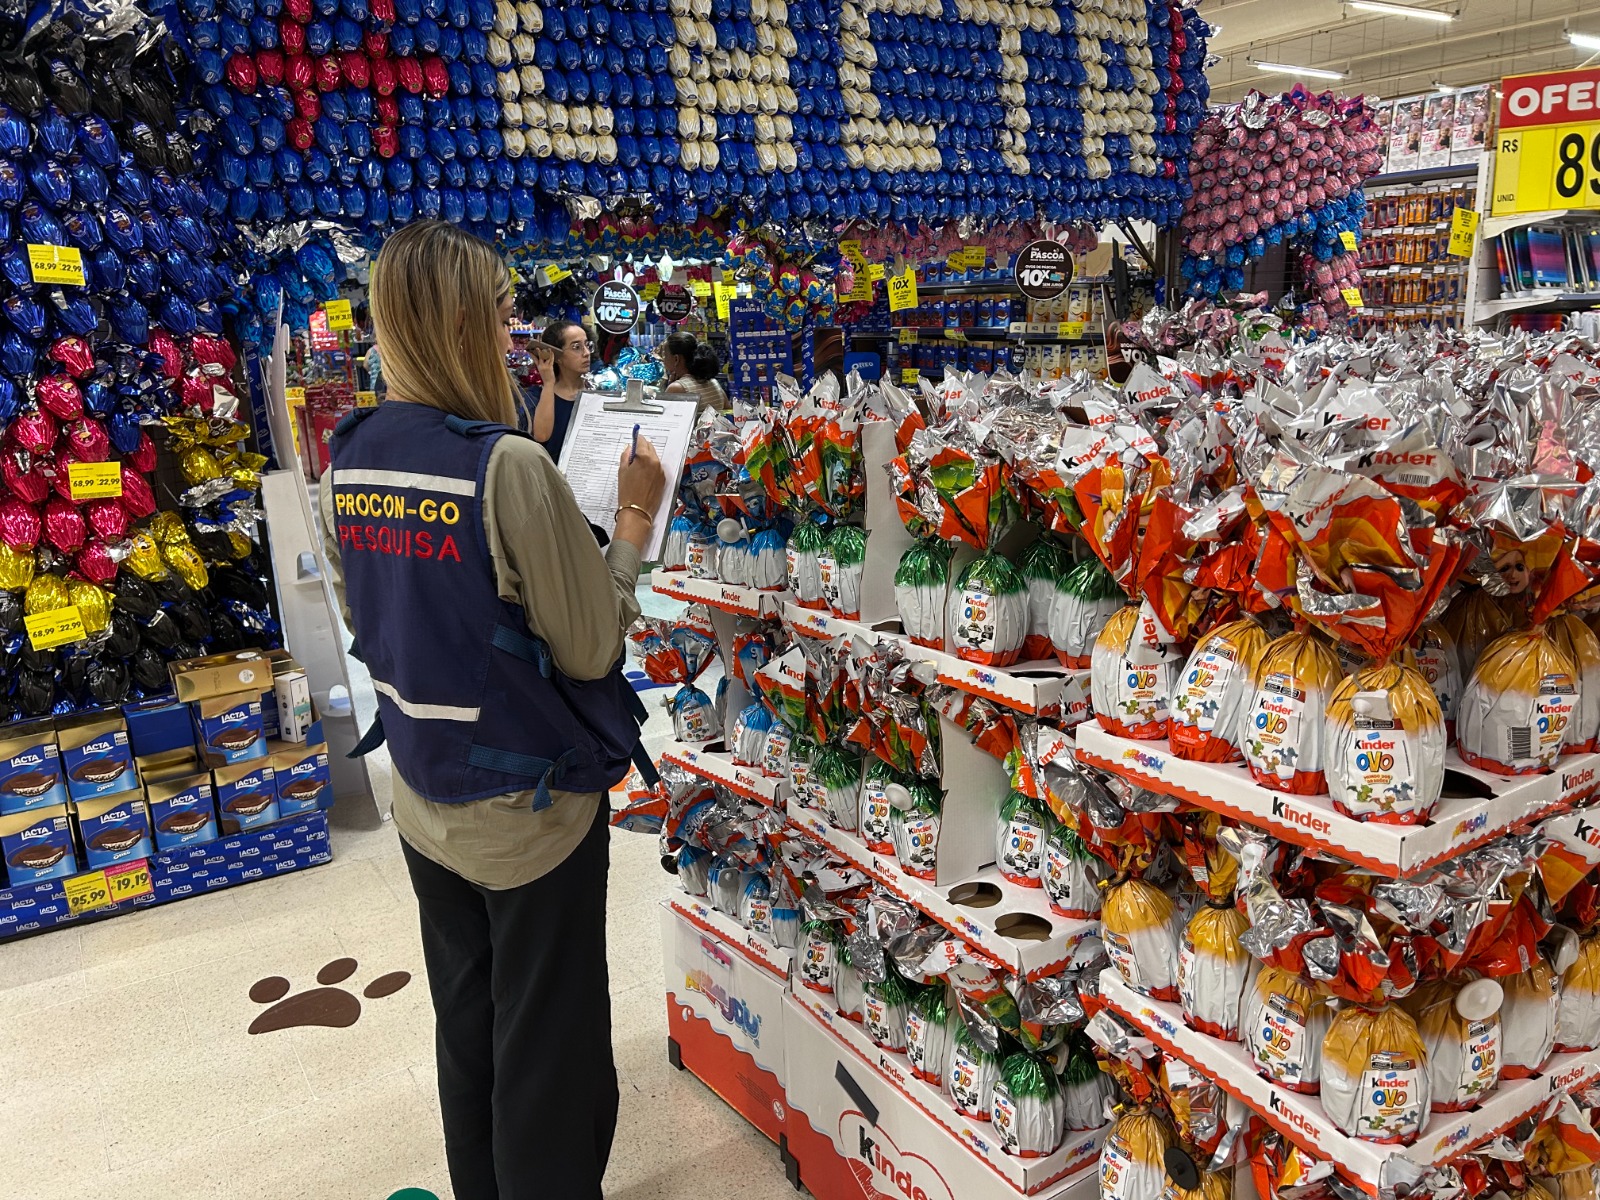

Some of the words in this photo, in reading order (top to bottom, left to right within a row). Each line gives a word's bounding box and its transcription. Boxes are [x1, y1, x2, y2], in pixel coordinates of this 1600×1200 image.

[1508, 81, 1600, 117] OFE
[1502, 140, 1518, 153] R$
[35, 262, 56, 270] 68,99
[62, 264, 81, 272] 22,99
[893, 279, 909, 290] 10X
[1020, 269, 1050, 287] 10X
[1128, 386, 1171, 404] Kinder
[1062, 436, 1107, 469] Kinder
[1358, 451, 1437, 468] Kinder
[73, 479, 94, 487] 68,99
[99, 478, 120, 486] 22,99
[335, 493, 460, 525] PROCON-GO
[339, 525, 462, 563] PESQUISA
[721, 588, 740, 602] Kinder
[966, 596, 988, 607] Kinder
[965, 606, 986, 621] OVO
[33, 627, 55, 638] 68,99
[60, 621, 81, 631] 22,99
[1127, 671, 1157, 689] OVO
[1259, 698, 1293, 715] Kinder
[1537, 703, 1572, 714] Kinder
[221, 711, 248, 724] LACTA
[1255, 712, 1287, 734] OVO
[1537, 714, 1567, 733] OVO
[82, 741, 114, 755] LACTA
[1354, 738, 1395, 750] Kinder
[10, 754, 43, 768] LACTA
[1356, 751, 1394, 772] OVO
[291, 763, 316, 775] LACTA
[235, 777, 261, 789] LACTA
[735, 770, 756, 787] Kinder
[1562, 768, 1595, 792] Kinder
[170, 794, 198, 807] LACTA
[100, 810, 130, 824] LACTA
[869, 804, 888, 817] OVO
[1272, 796, 1331, 834] Kinder
[20, 826, 53, 841] LACTA
[908, 825, 932, 835] Kinder
[1012, 827, 1037, 839] Kinder
[273, 839, 294, 850] LACTA
[912, 833, 933, 847] OVO
[1011, 837, 1034, 852] OVO
[239, 847, 260, 857] LACTA
[309, 852, 329, 862] LACTA
[203, 855, 225, 865] LACTA
[275, 859, 296, 870] LACTA
[167, 863, 189, 873] LACTA
[242, 867, 263, 878] LACTA
[873, 856, 898, 879] Kinder
[35, 882, 53, 892] LACTA
[117, 872, 148, 891] 19,19
[155, 878, 172, 887] LACTA
[206, 876, 228, 887] LACTA
[170, 884, 192, 895] LACTA
[11, 898, 36, 909] LACTA
[71, 890, 105, 907] 95,99
[39, 905, 58, 914] LACTA
[15, 921, 40, 932] LACTA
[747, 934, 768, 956] Kinder
[807, 950, 824, 962] OVO
[1264, 1012, 1295, 1037] Kinder
[1263, 1027, 1290, 1051] OVO
[1470, 1036, 1496, 1054] Kinder
[955, 1059, 974, 1075] Kinder
[1472, 1049, 1496, 1071] OVO
[880, 1054, 905, 1084] Kinder
[954, 1070, 971, 1087] OVO
[1372, 1077, 1409, 1088] Kinder
[1550, 1065, 1585, 1093] Kinder
[1372, 1089, 1407, 1108] OVO
[995, 1108, 1010, 1127] OVO
[1269, 1090, 1321, 1141] Kinder
[1102, 1163, 1118, 1184] OVO
